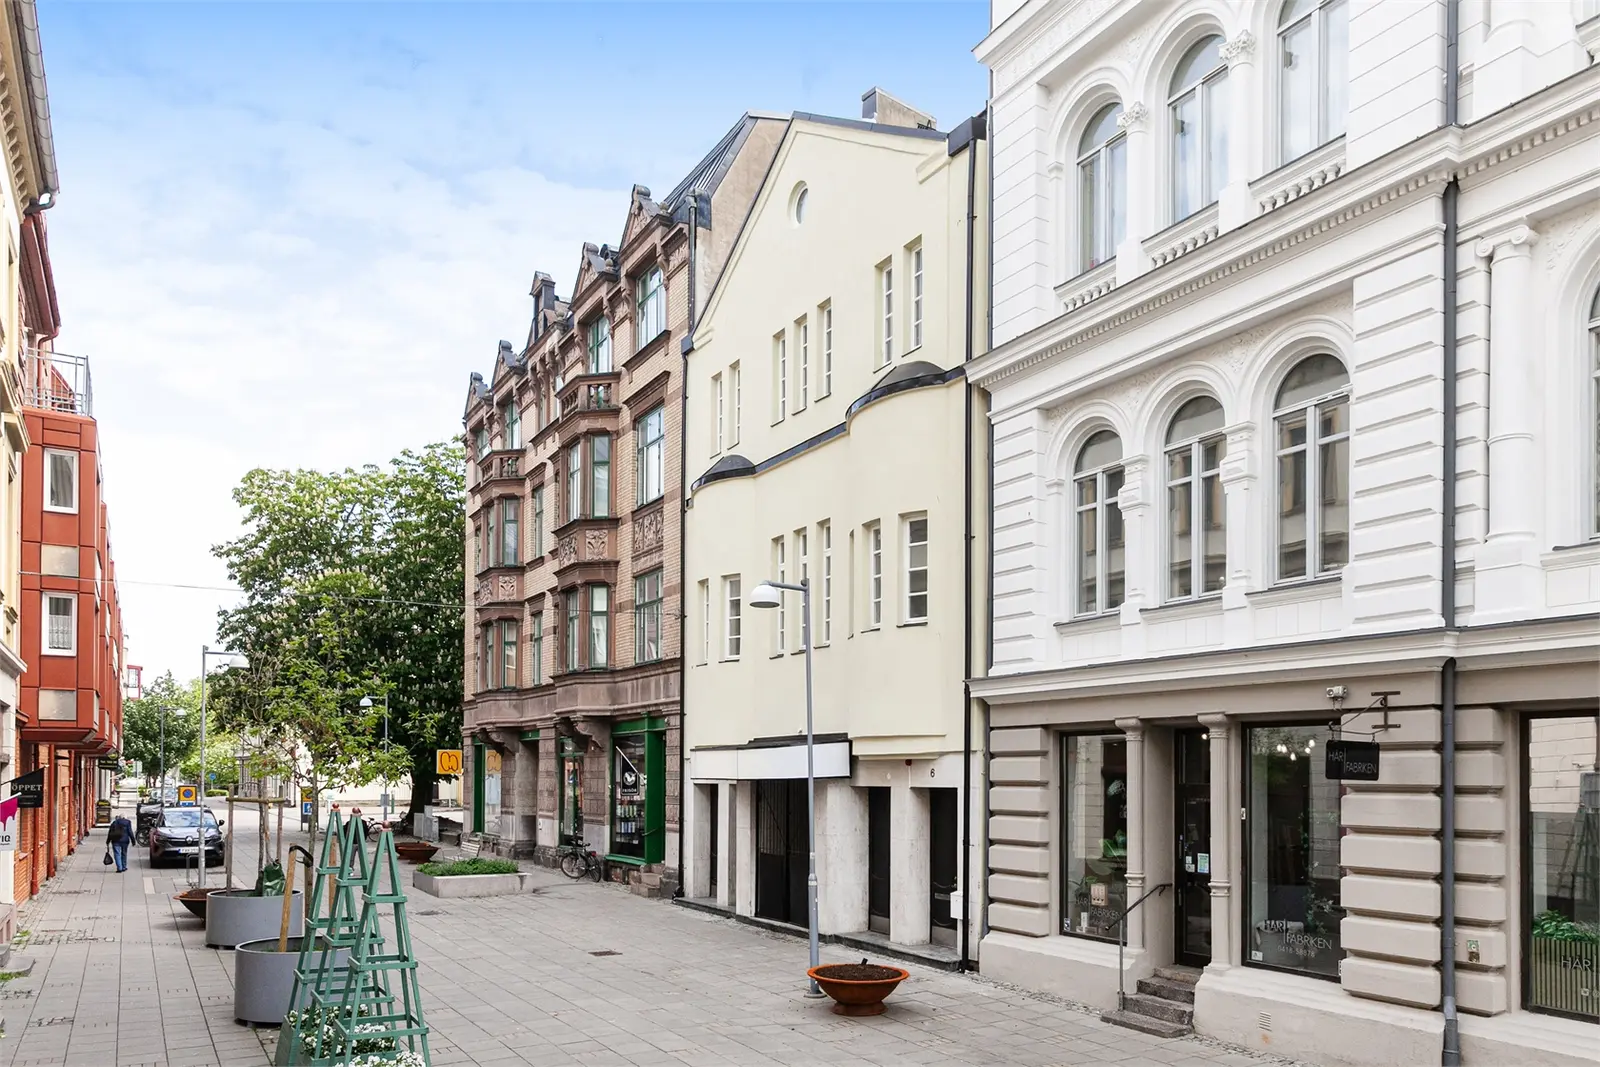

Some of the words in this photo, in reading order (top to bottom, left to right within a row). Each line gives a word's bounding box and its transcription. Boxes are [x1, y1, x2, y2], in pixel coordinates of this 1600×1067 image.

[930, 768, 936, 778] 6
[1345, 761, 1377, 774] FABRIKEN
[12, 783, 42, 791] ÖPPET
[1286, 932, 1333, 950] FABRIKEN
